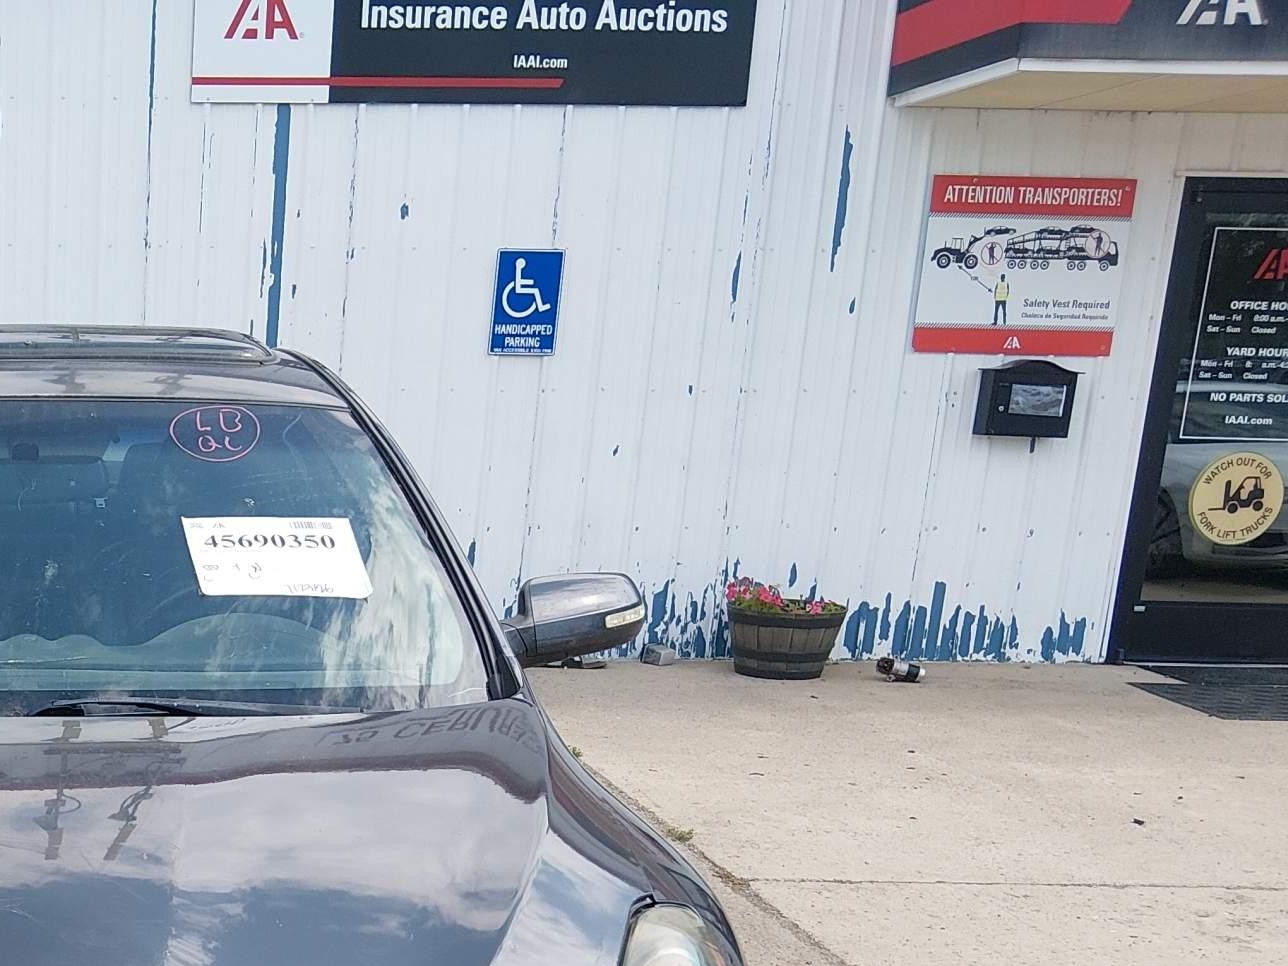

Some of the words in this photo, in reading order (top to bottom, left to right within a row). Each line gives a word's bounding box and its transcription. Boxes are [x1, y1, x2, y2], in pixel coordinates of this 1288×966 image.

[361, 0, 507, 30] Insurance
[516, 0, 586, 31] Auto
[595, 0, 728, 32] Auctions
[513, 55, 568, 69] IAAI.com
[944, 185, 1014, 204] ATTENTION
[1018, 187, 1122, 207] TRANSPORTERS!
[1023, 298, 1050, 309] Safety
[1052, 299, 1070, 308] Vest
[1072, 300, 1110, 311] Required
[1230, 300, 1269, 310] OFFICE
[1208, 313, 1225, 321] Mon
[494, 323, 553, 335] HANDICAPPED
[1206, 325, 1220, 333] Sat
[1225, 325, 1241, 333] Sun
[1251, 326, 1277, 334] Closed
[504, 336, 541, 347] PARKING
[1226, 347, 1256, 356] YARD
[1224, 360, 1234, 368] Fri
[1210, 392, 1227, 402] NO
[1229, 393, 1264, 403] PARTS
[1224, 415, 1273, 425] IAAI.com
[1203, 459, 1234, 485] WATCH
[1236, 457, 1256, 467] OUT
[1255, 462, 1272, 480] FOR
[1197, 511, 1216, 534] FORK
[1216, 528, 1238, 539] LIFT
[1239, 506, 1273, 537] TRUCKS
[203, 534, 336, 550] 45690350
